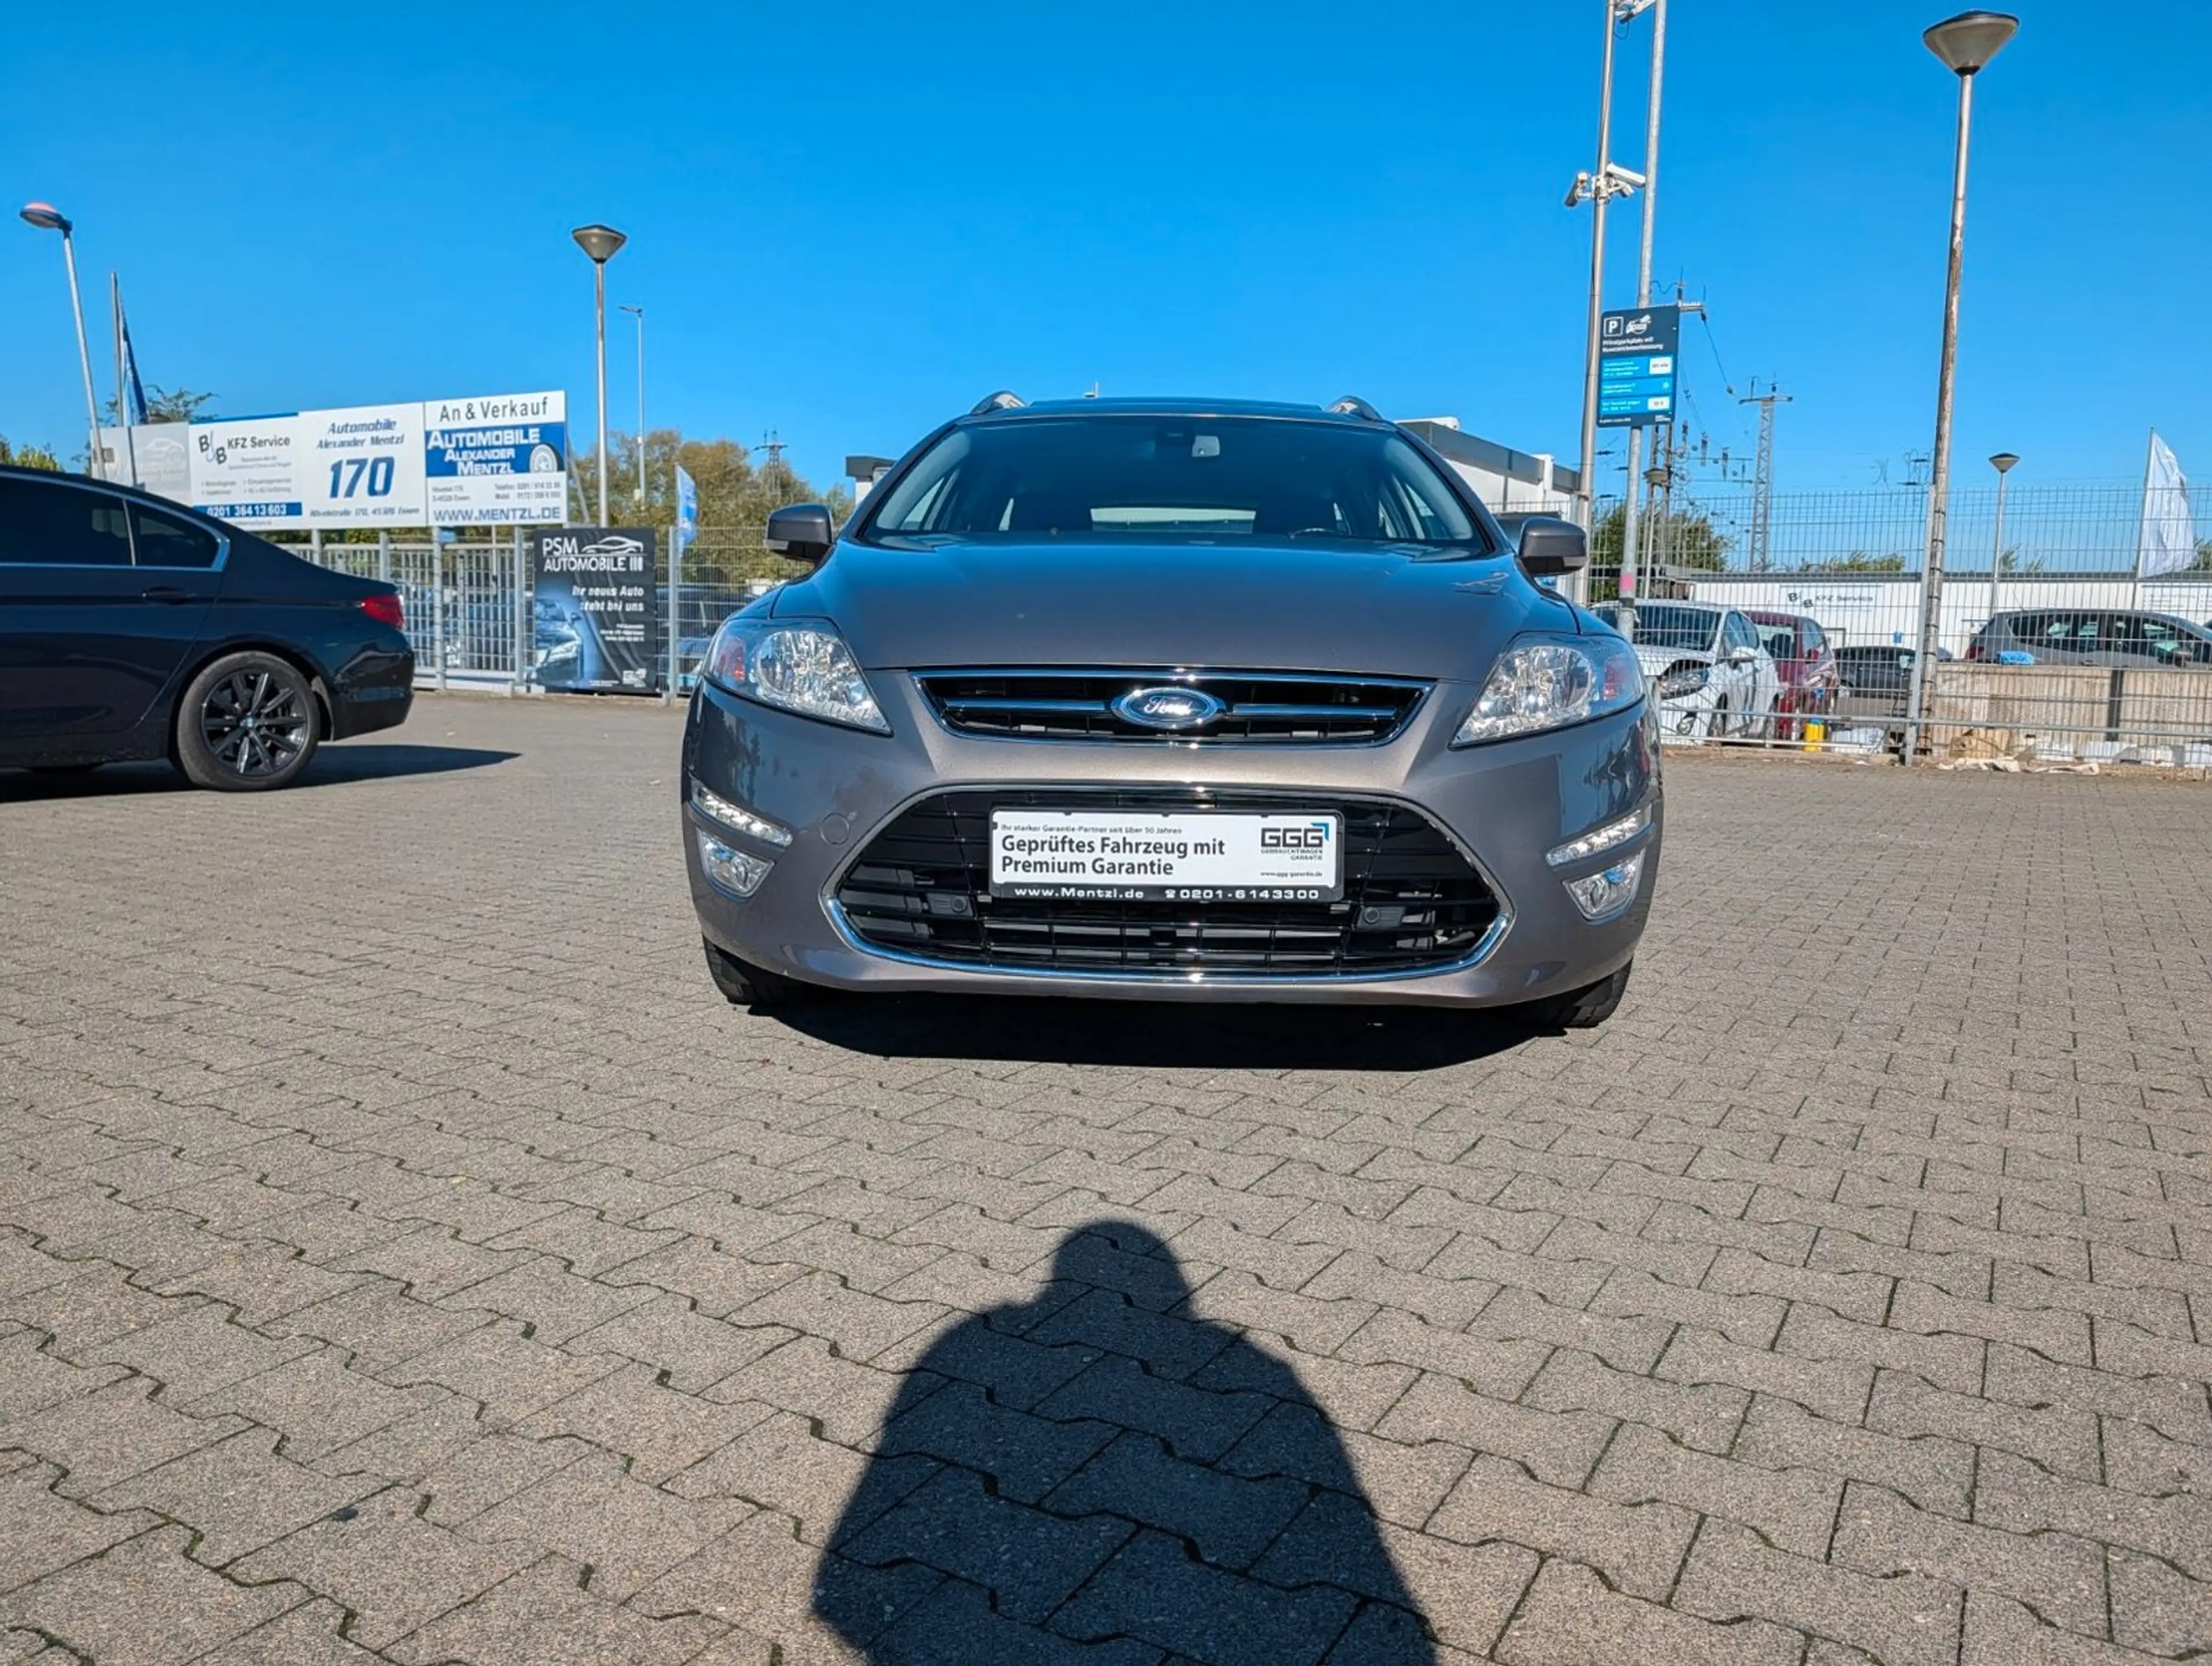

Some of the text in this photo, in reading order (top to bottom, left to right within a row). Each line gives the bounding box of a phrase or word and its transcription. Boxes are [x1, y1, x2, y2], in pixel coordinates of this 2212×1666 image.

[1609, 320, 1618, 334] P
[439, 396, 549, 423] An & Verkauf
[328, 418, 398, 434] Automobile
[227, 434, 291, 449] KFZ Service
[316, 434, 405, 449] Alexander Mentzl
[427, 427, 541, 449] AUTOMOBILE
[330, 455, 395, 499] 170
[433, 507, 561, 521] WWW.MENTZL.DE
[543, 537, 578, 556] PSM
[544, 556, 627, 572] AUTOMOBILE
[620, 585, 645, 596] Auto
[625, 602, 645, 611] uns
[1261, 828, 1323, 847] GGG
[1002, 835, 1225, 859] Geprüftes Fahrzeug mit
[1002, 856, 1173, 875] Premium Garantie
[1014, 887, 1319, 900] www.Mentzl.de 0201-6143300
